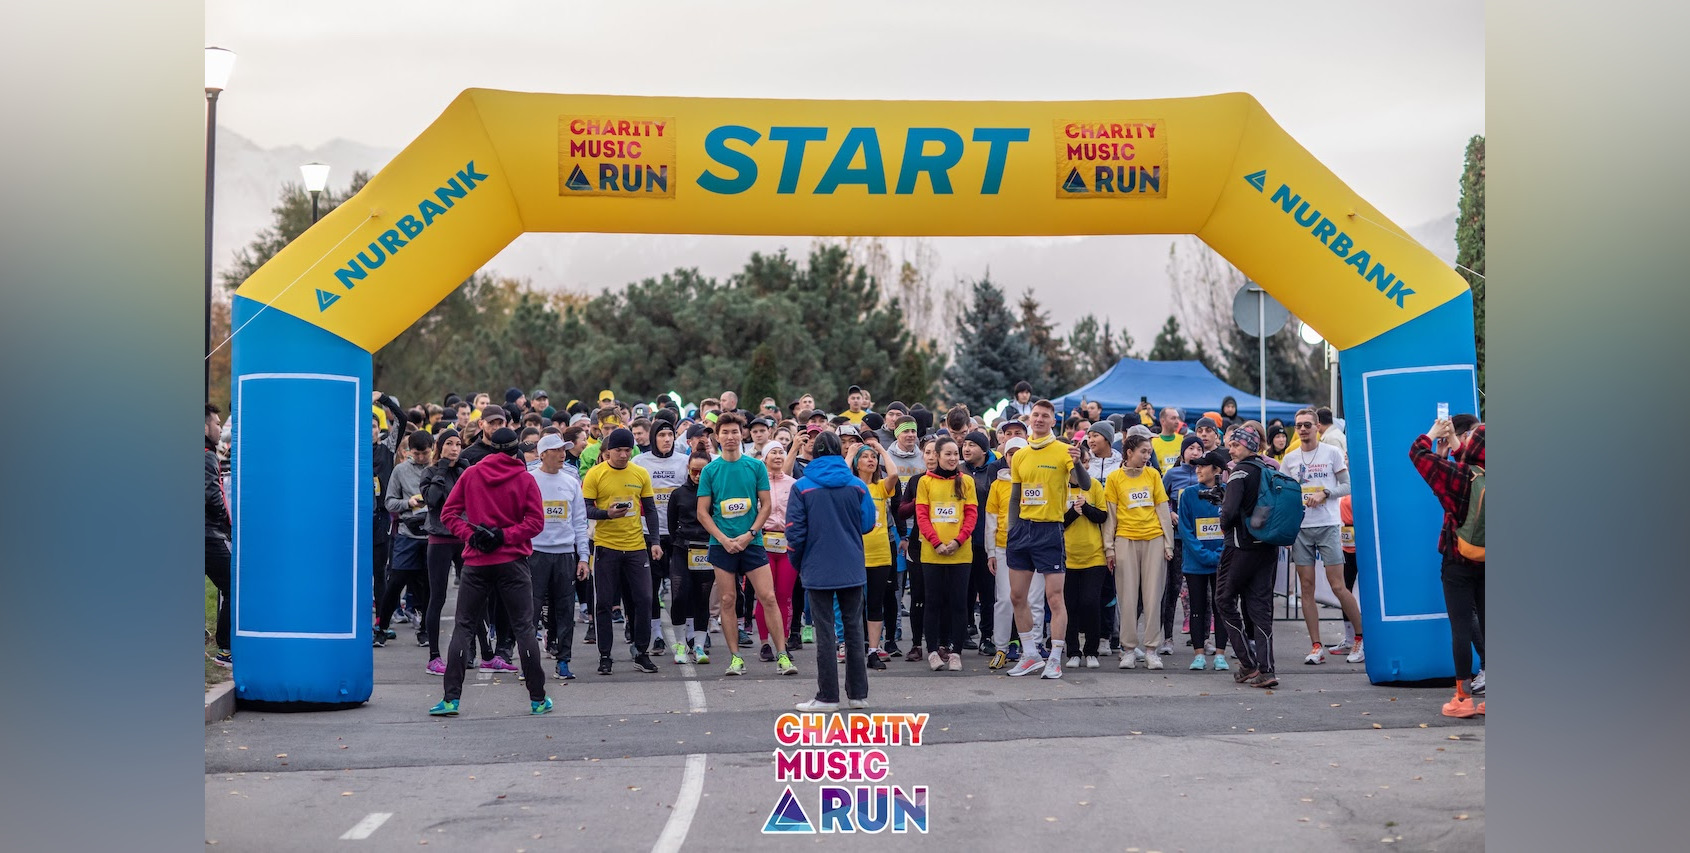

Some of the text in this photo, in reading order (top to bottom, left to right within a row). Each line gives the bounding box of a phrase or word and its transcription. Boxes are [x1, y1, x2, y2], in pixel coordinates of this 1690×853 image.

[570, 119, 667, 138] CHARITY
[1064, 122, 1157, 140] CHARITY
[570, 140, 642, 159] MUSIC
[1067, 143, 1135, 161] MUSIC
[695, 125, 1031, 195] START
[599, 163, 668, 193] RUN
[1095, 165, 1160, 193] RUN
[334, 160, 489, 290] NURBANK
[1270, 183, 1416, 309] NURBANK
[1024, 489, 1041, 497] 690
[1131, 491, 1149, 500] 802
[546, 507, 563, 515] 842
[728, 503, 745, 511] 692
[937, 508, 954, 516] 746
